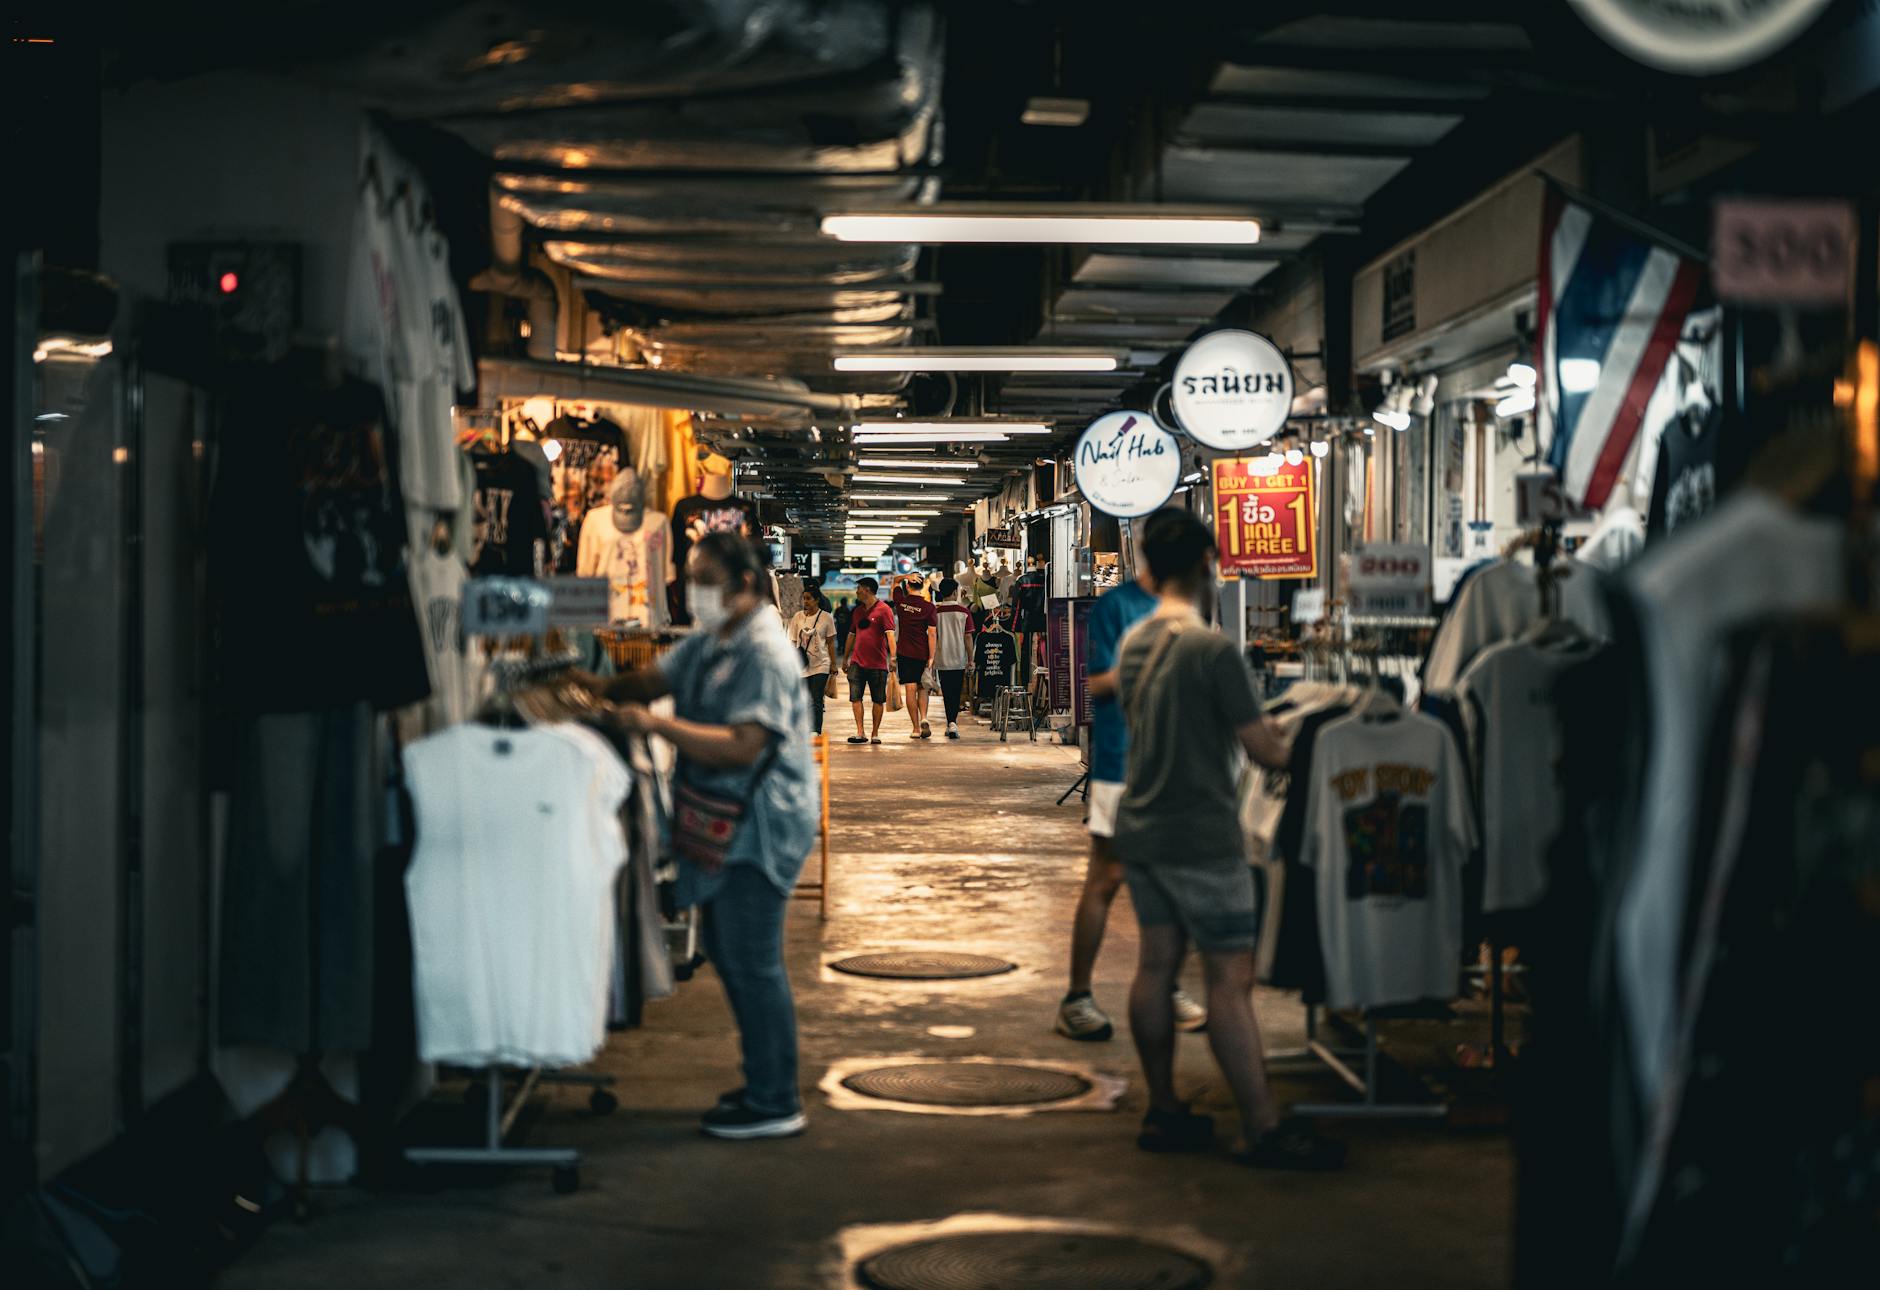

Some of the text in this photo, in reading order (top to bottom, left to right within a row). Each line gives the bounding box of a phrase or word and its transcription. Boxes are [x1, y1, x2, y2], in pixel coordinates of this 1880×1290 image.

[1081, 434, 1164, 466] Nail Hub
[1219, 474, 1307, 489] BUY 1 GET 1
[1221, 495, 1240, 556] 1
[1286, 492, 1307, 553] 1
[1244, 538, 1293, 555] FREE
